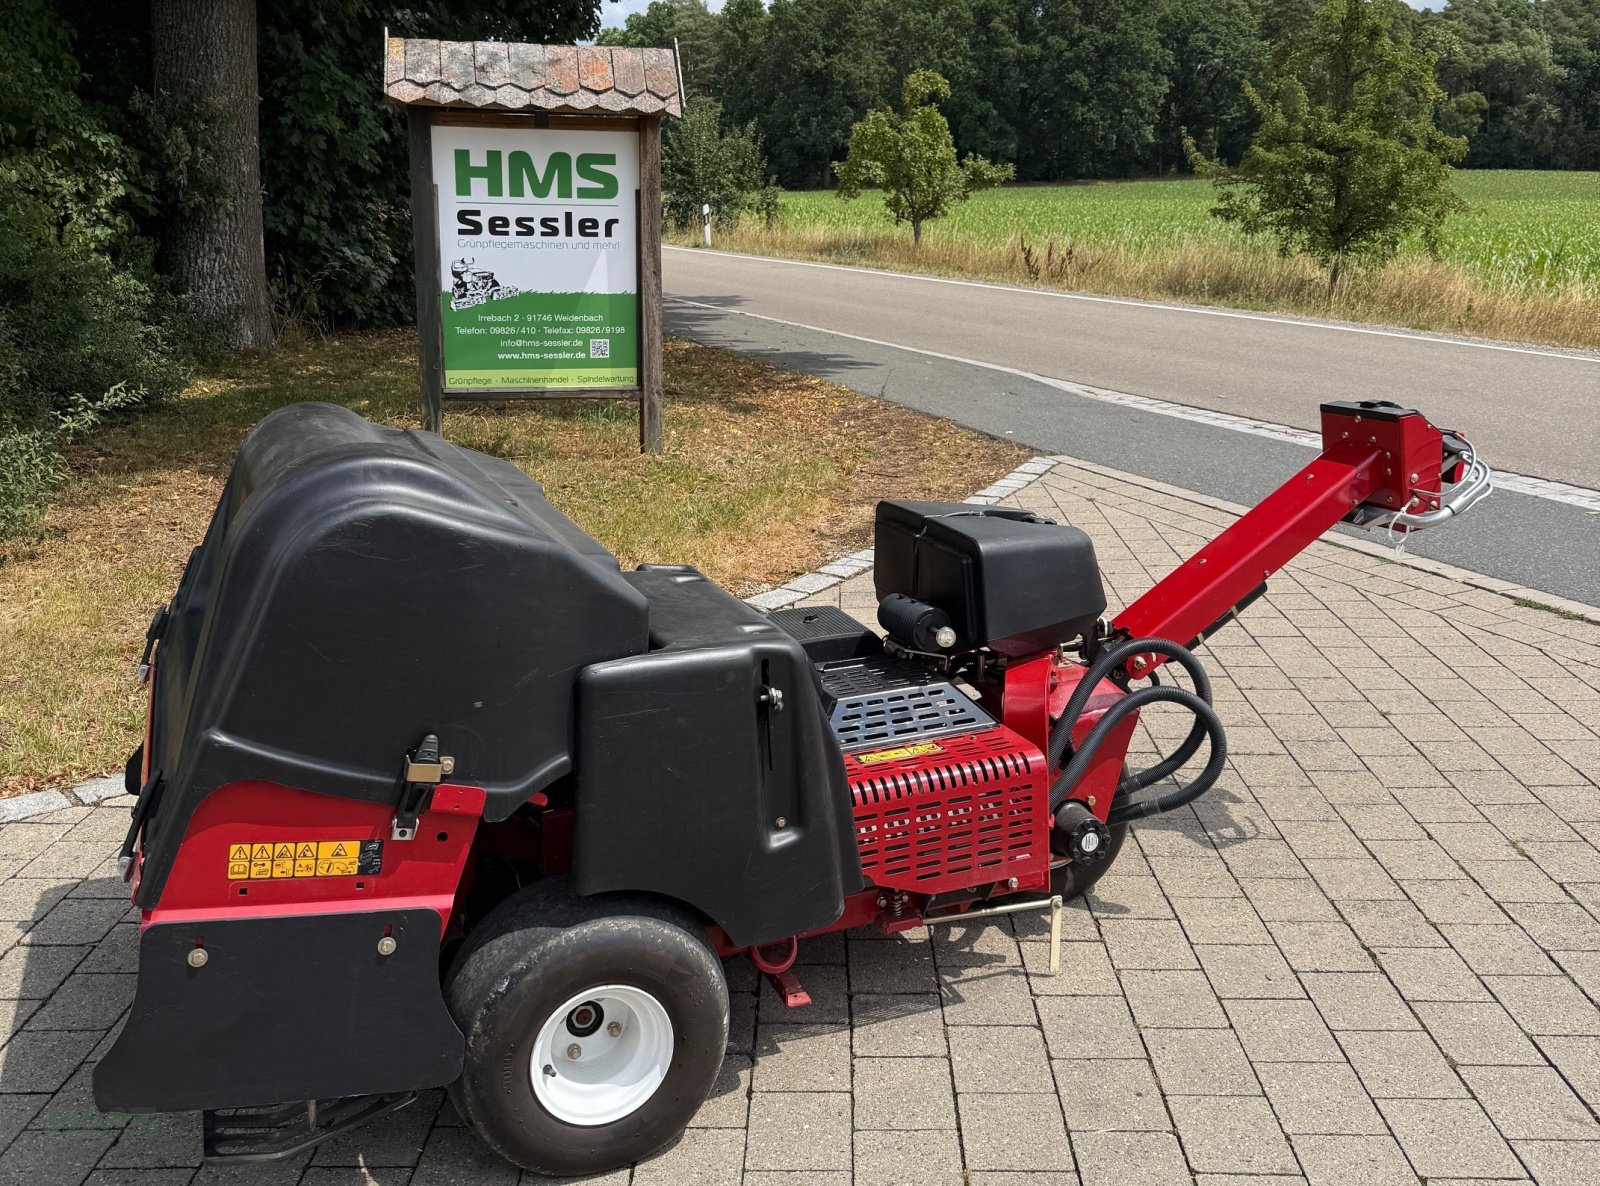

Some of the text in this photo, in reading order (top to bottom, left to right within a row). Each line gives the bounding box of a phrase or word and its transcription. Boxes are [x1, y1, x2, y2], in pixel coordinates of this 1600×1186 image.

[454, 149, 619, 199] HMS
[457, 209, 619, 237] Sessler
[457, 239, 620, 250] Grünpflegemaschinen und mehr!
[478, 314, 603, 322] Irrebach 2 91746 Weidenbach
[455, 327, 488, 335] Telefon:
[543, 327, 574, 335] Telefax:
[500, 339, 583, 347] info@hms-sessler.de
[497, 352, 586, 360] www.hms-sessler.de
[449, 375, 634, 386] Grünpflege Maschinenhandel Spindelwartung
